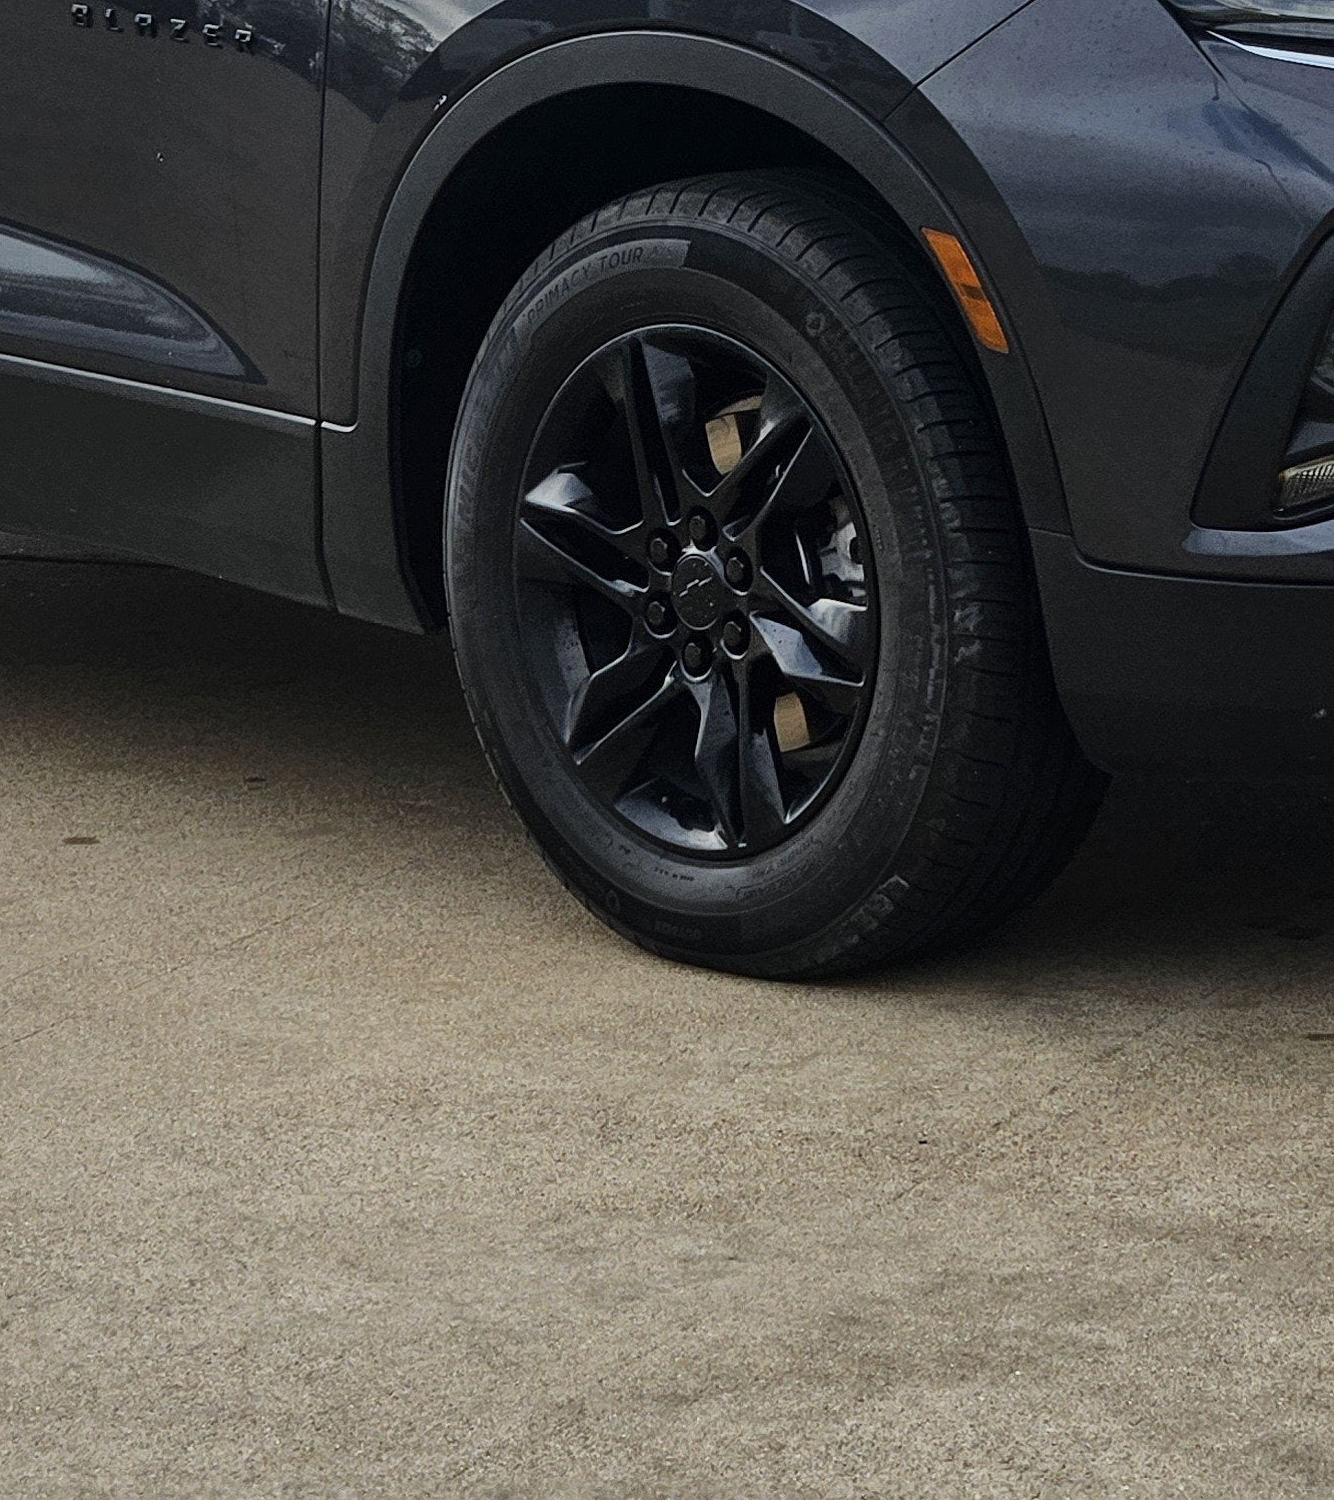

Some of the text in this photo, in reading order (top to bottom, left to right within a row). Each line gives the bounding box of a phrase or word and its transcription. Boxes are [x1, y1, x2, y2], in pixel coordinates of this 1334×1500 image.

[70, 3, 255, 52] BLAZER
[527, 263, 592, 324] PRIMACY
[598, 246, 644, 272] TOUR
